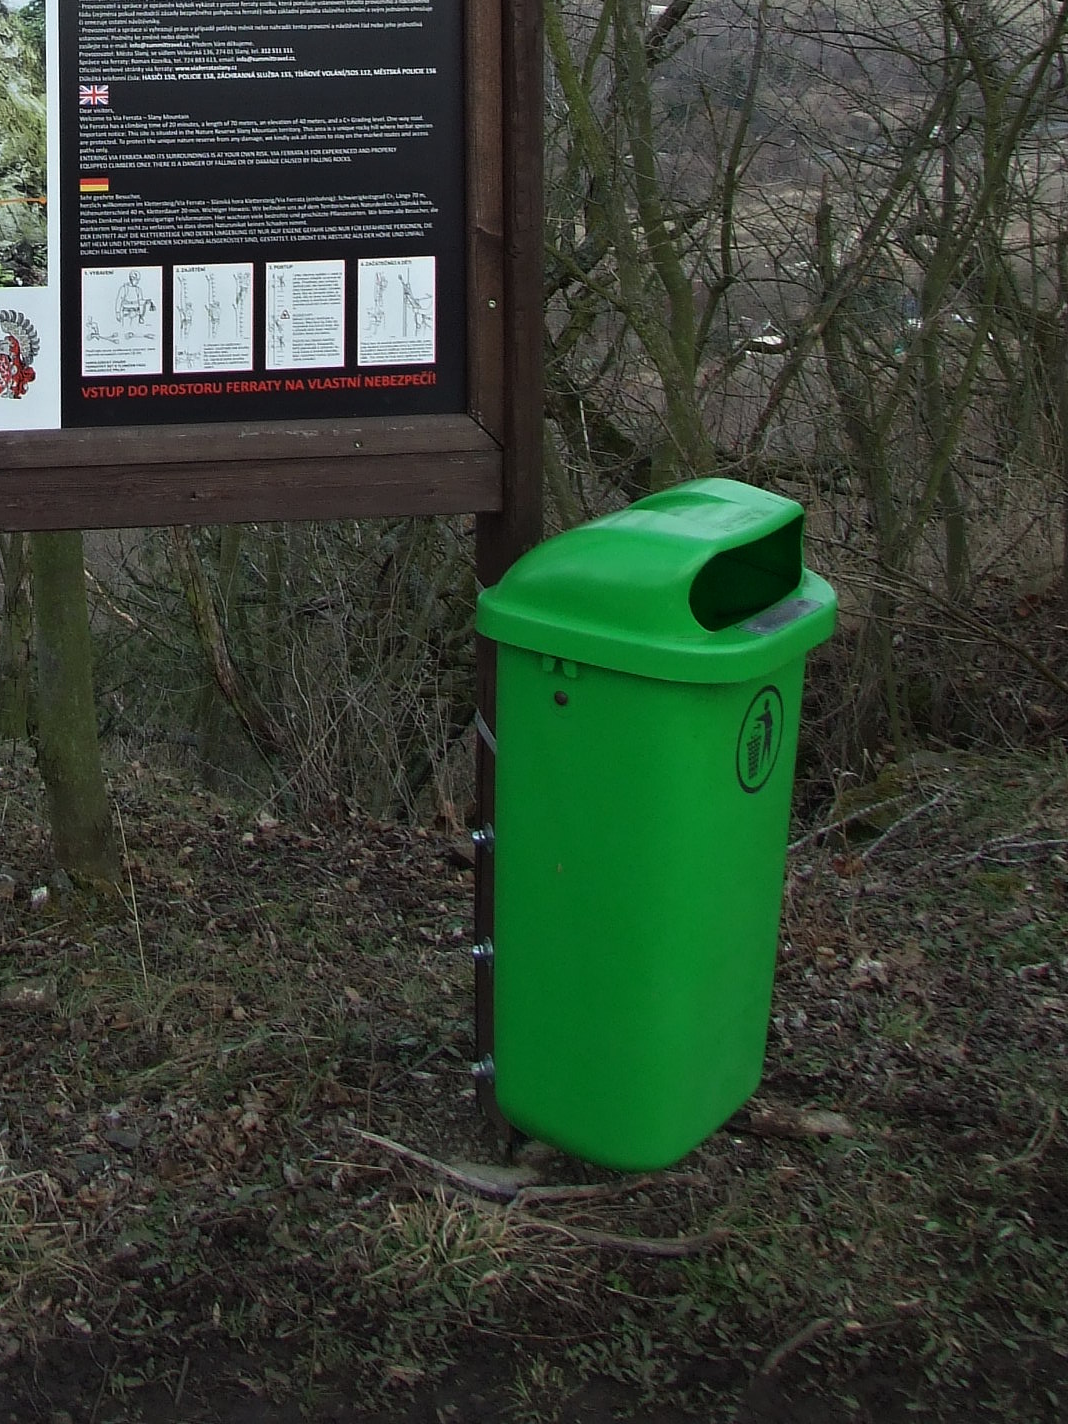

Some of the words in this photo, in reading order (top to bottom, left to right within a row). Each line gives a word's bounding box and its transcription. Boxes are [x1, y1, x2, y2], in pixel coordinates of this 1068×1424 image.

[82, 386, 124, 398] VSTUP
[128, 385, 148, 397] DO
[152, 382, 222, 396] PROSTORU
[226, 380, 281, 393] FERRATY
[285, 379, 304, 391] NA
[308, 374, 362, 389] VLASTNÍ
[364, 371, 436, 387] NEBEZPEČÍ!
